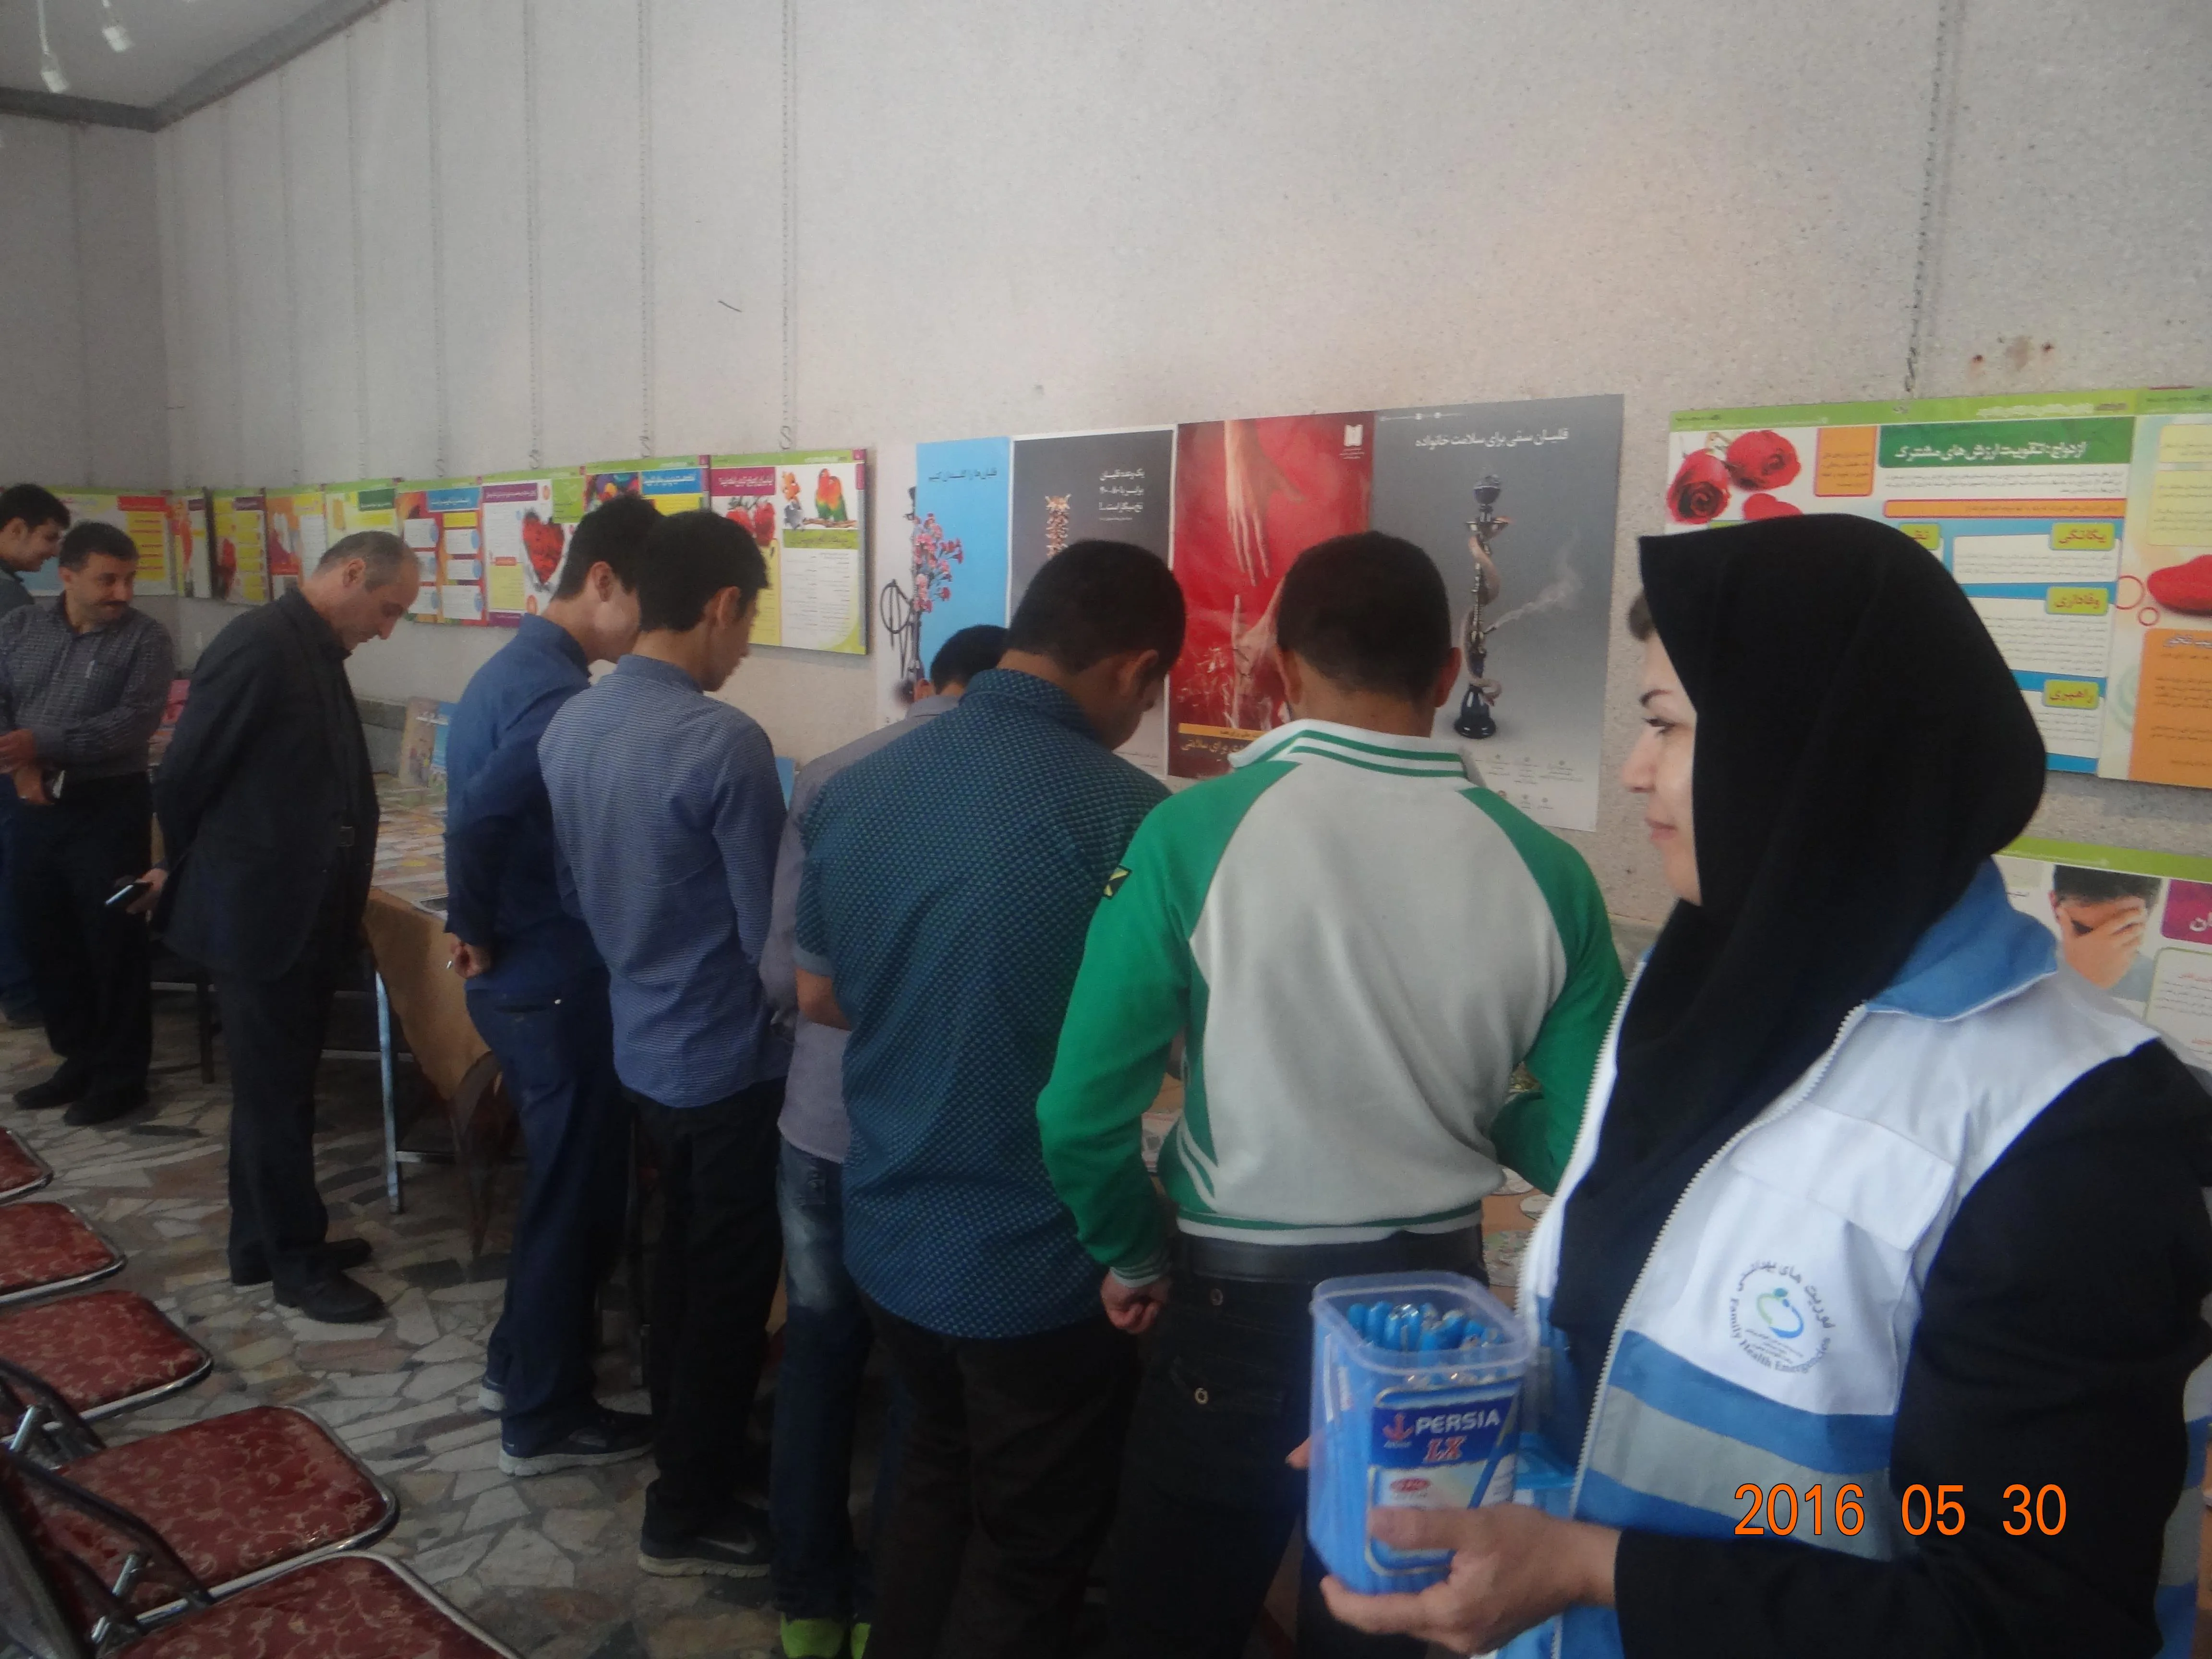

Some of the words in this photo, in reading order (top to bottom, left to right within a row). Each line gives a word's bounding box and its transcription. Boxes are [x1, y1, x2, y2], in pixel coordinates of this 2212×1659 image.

[2058, 529, 2107, 544] یگانگی
[2054, 592, 2101, 609] وفاداری
[1730, 1297, 1742, 1338] Family
[1739, 1338, 1772, 1369] Health
[1415, 1409, 1501, 1435] PERSIA
[1422, 1435, 1467, 1464] LX
